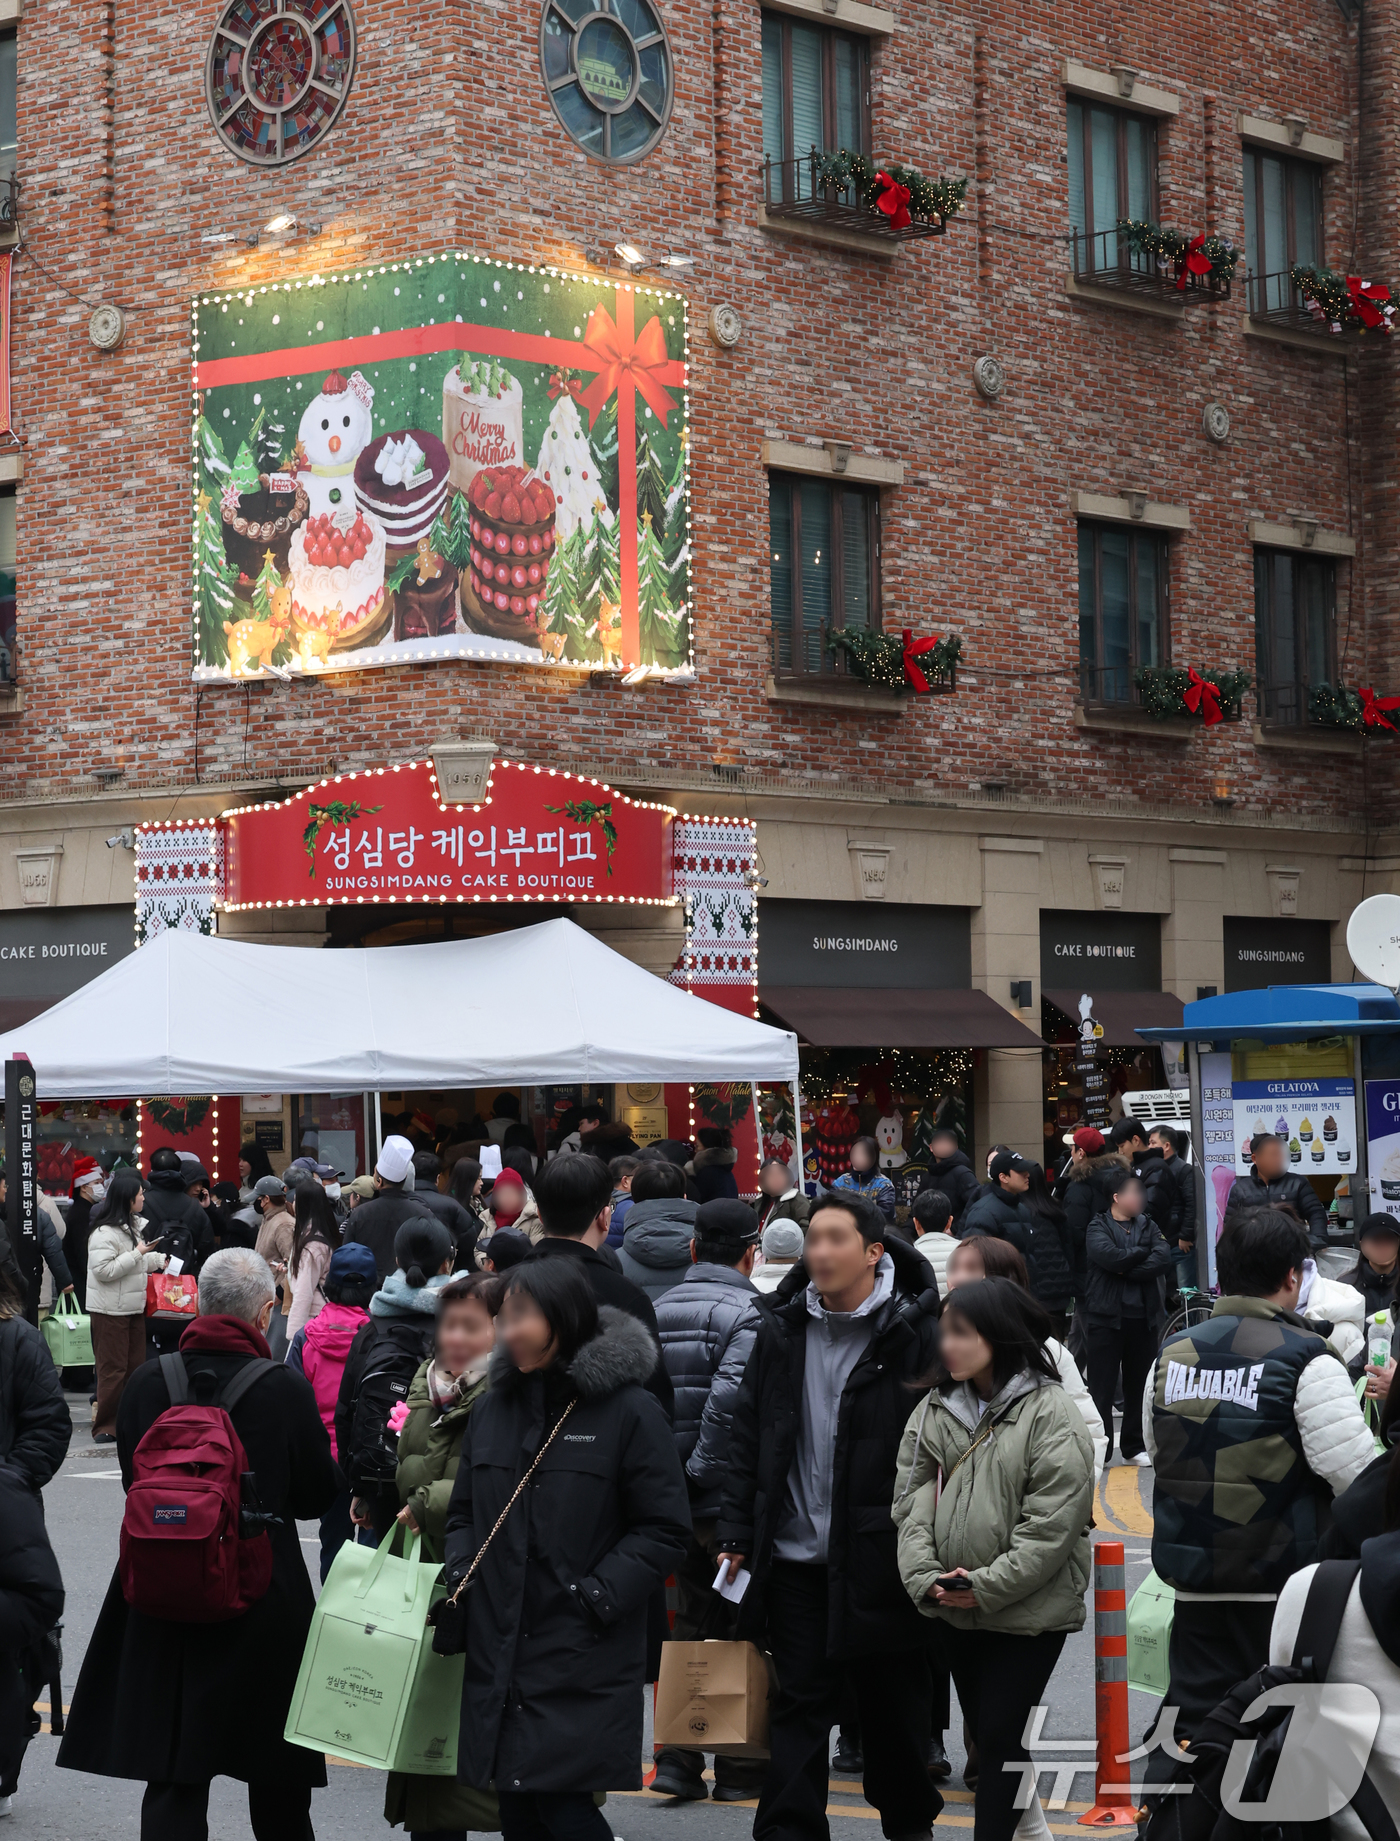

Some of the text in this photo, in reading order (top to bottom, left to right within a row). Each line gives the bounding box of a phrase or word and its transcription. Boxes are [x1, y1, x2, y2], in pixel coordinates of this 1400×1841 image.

[460, 411, 508, 447] Merry
[452, 430, 516, 466] Christmas
[446, 772, 481, 785] 1956
[323, 825, 597, 870] 성심당 케익부띠끄
[24, 873, 47, 888] 1956
[325, 874, 595, 889] SUNGSIMDANG CAKE BOUTIQUE
[863, 869, 886, 882] 1956
[1102, 881, 1122, 893] 1956
[0, 942, 108, 960] CAKE BOUTIQUE
[812, 936, 898, 952] SUNGSIMDANG
[1054, 943, 1136, 958] CAKE BOUTIQUE
[1237, 949, 1305, 963] SUNGSIMDANG
[692, 1081, 752, 1099] Buon Natale
[1203, 1087, 1232, 1102] 쫀득해
[1267, 1082, 1320, 1094] GELATOYA
[1144, 1093, 1163, 1101] DONGIN
[1203, 1109, 1233, 1123] 시원해
[1246, 1104, 1273, 1114] 이탈리아
[1274, 1103, 1289, 1113] 정통
[1291, 1103, 1319, 1112] 프리미엄
[1204, 1130, 1234, 1144] 젤라또
[1205, 1154, 1235, 1165] 아이스크림
[1164, 1359, 1265, 1412] VALUABLE
[326, 1675, 384, 1700] 성심당 케익부띠끄
